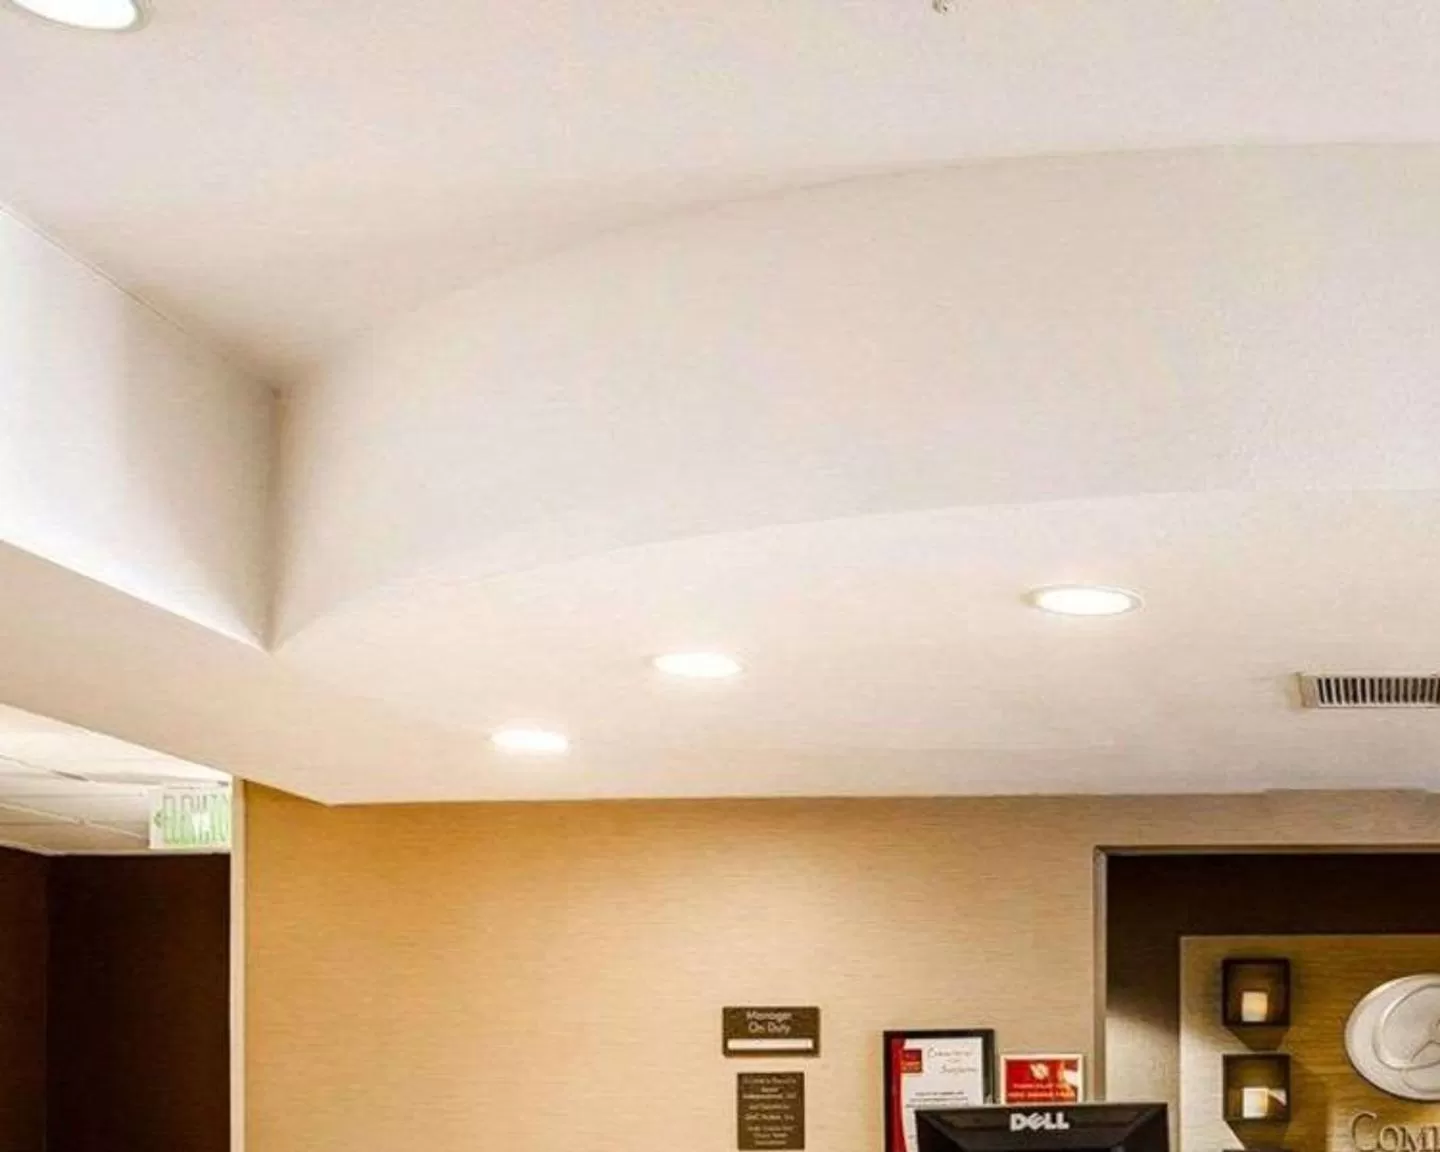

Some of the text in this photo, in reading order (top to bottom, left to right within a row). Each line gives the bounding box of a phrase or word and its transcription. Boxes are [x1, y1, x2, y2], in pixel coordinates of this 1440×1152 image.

[745, 1010, 792, 1023] Manager
[748, 1021, 791, 1035] On Duty
[1010, 1111, 1070, 1132] DELL
